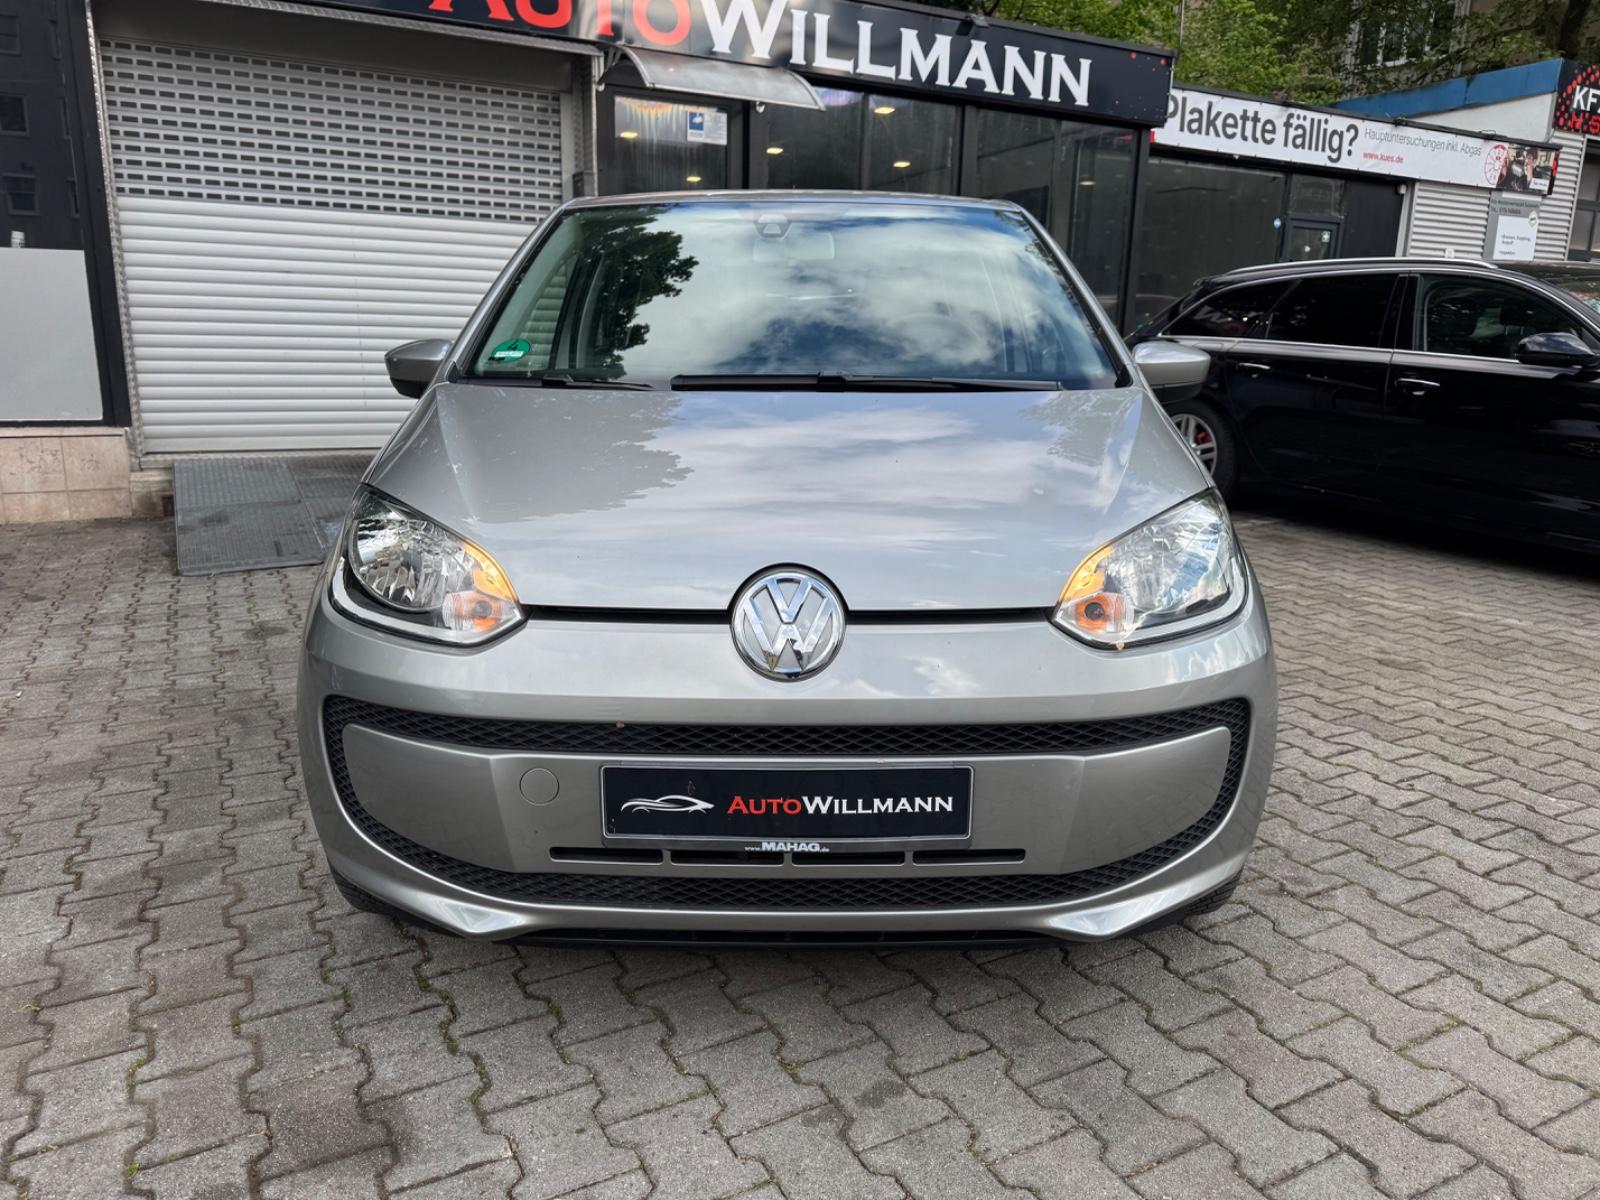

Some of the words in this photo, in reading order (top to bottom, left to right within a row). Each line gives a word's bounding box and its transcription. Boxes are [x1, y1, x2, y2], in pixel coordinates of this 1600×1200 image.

[428, 0, 1091, 107] UTOWILLMANN
[1573, 85, 1600, 114] KF
[1283, 112, 1359, 163] fällig?
[1364, 127, 1445, 151] Hauptuntersuchungen
[1460, 142, 1482, 156] Abgas
